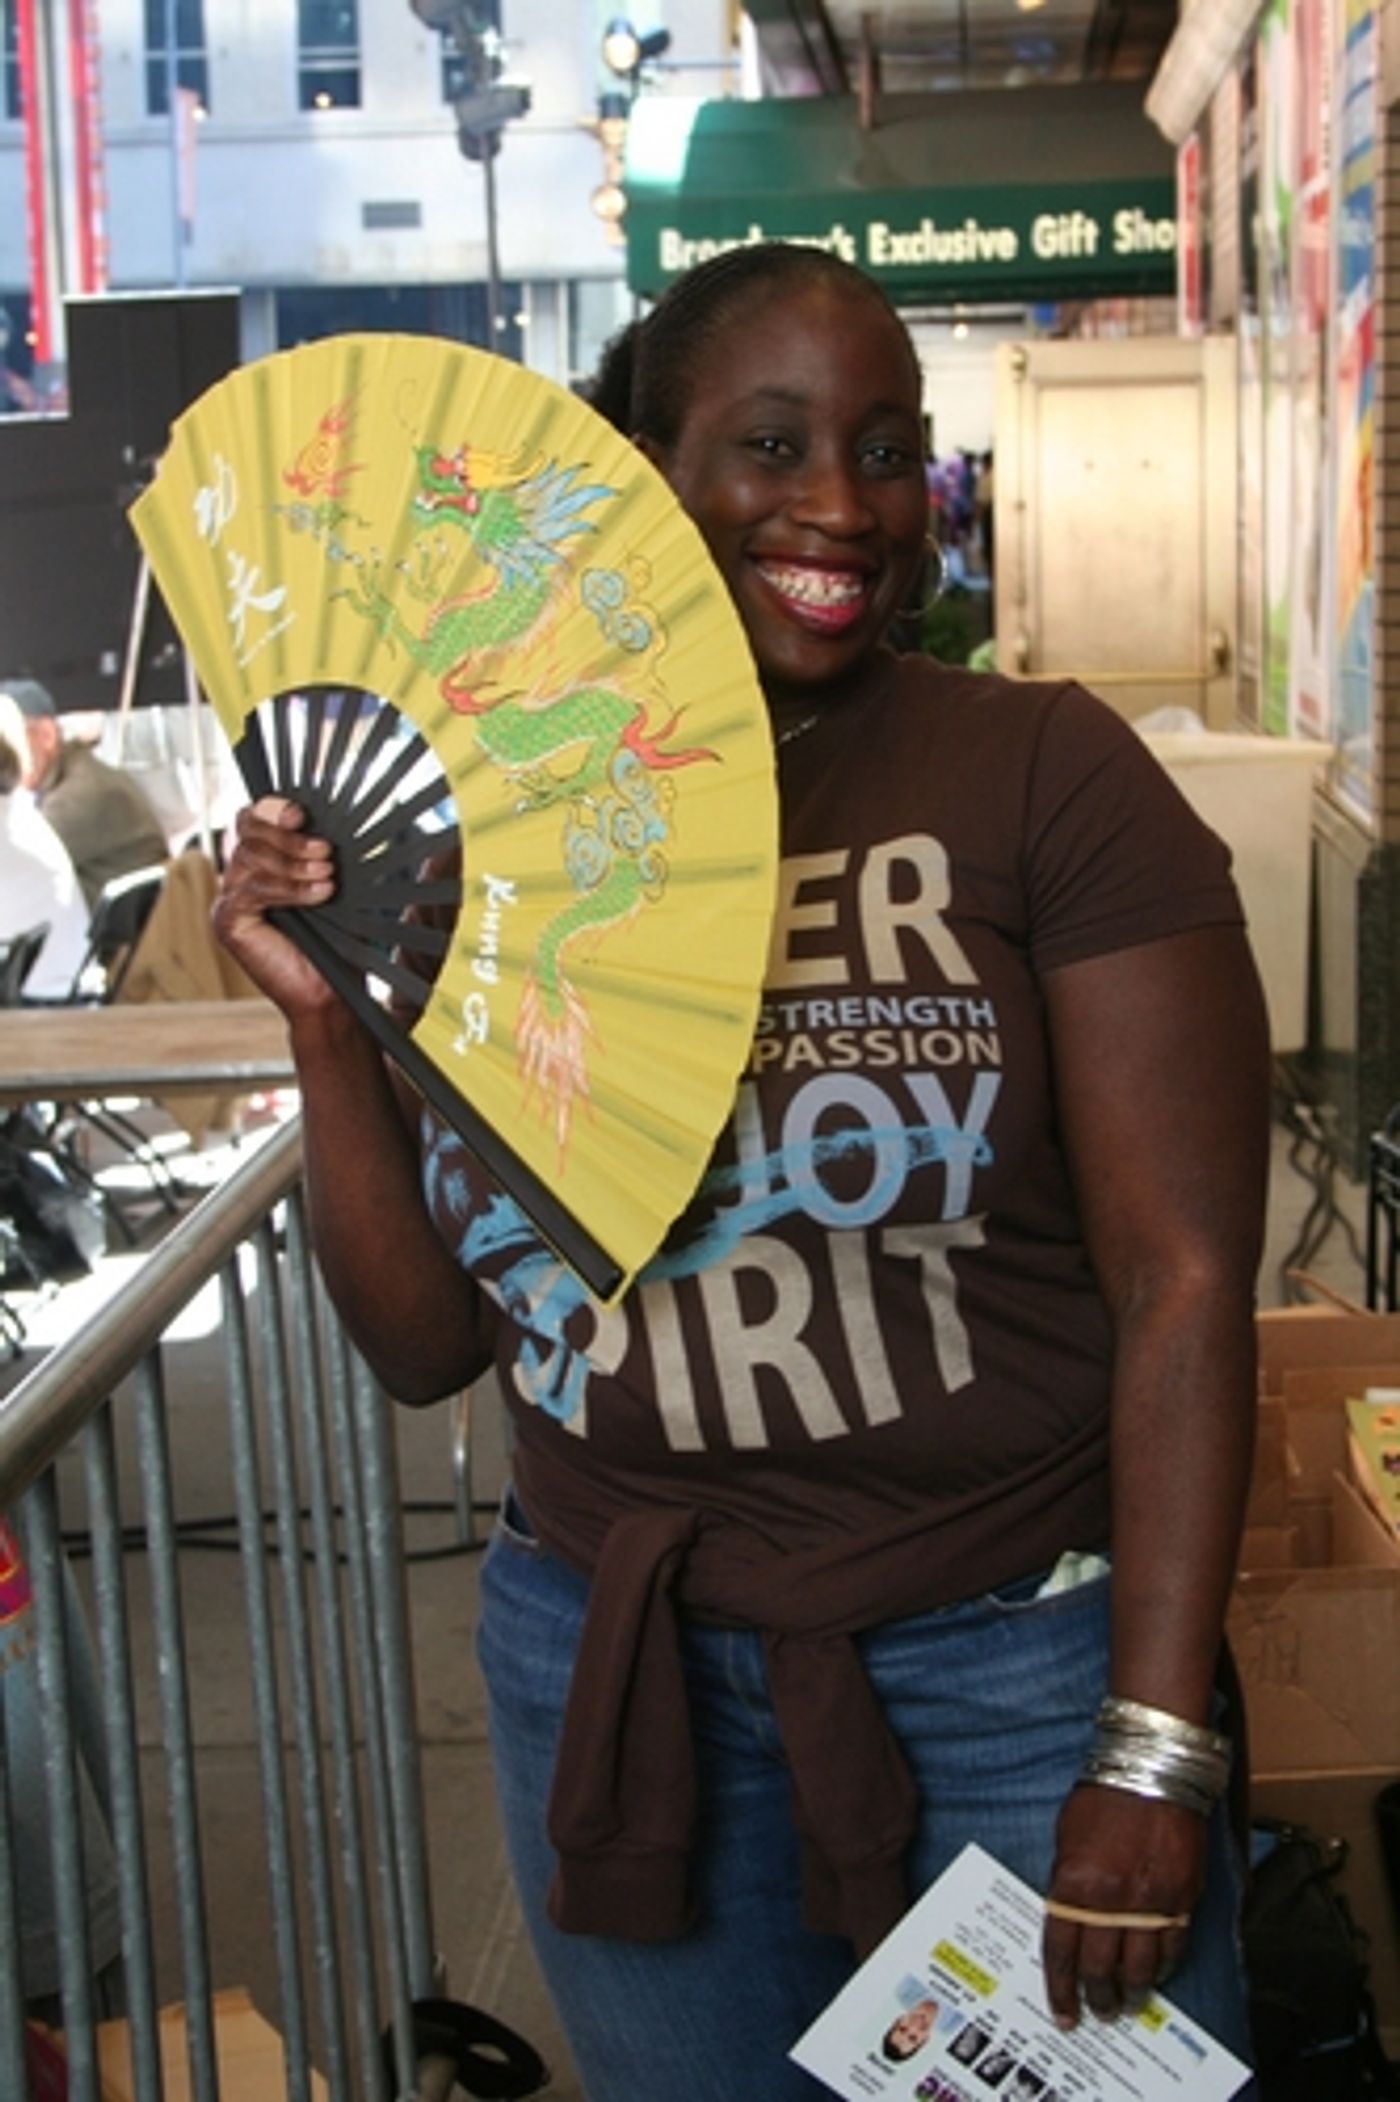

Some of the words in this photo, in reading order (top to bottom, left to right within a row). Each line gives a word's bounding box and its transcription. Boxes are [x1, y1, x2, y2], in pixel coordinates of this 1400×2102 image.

[867, 218, 1018, 266] Exclusive
[1032, 210, 1099, 259] Gift
[1113, 207, 1177, 254] Sho
